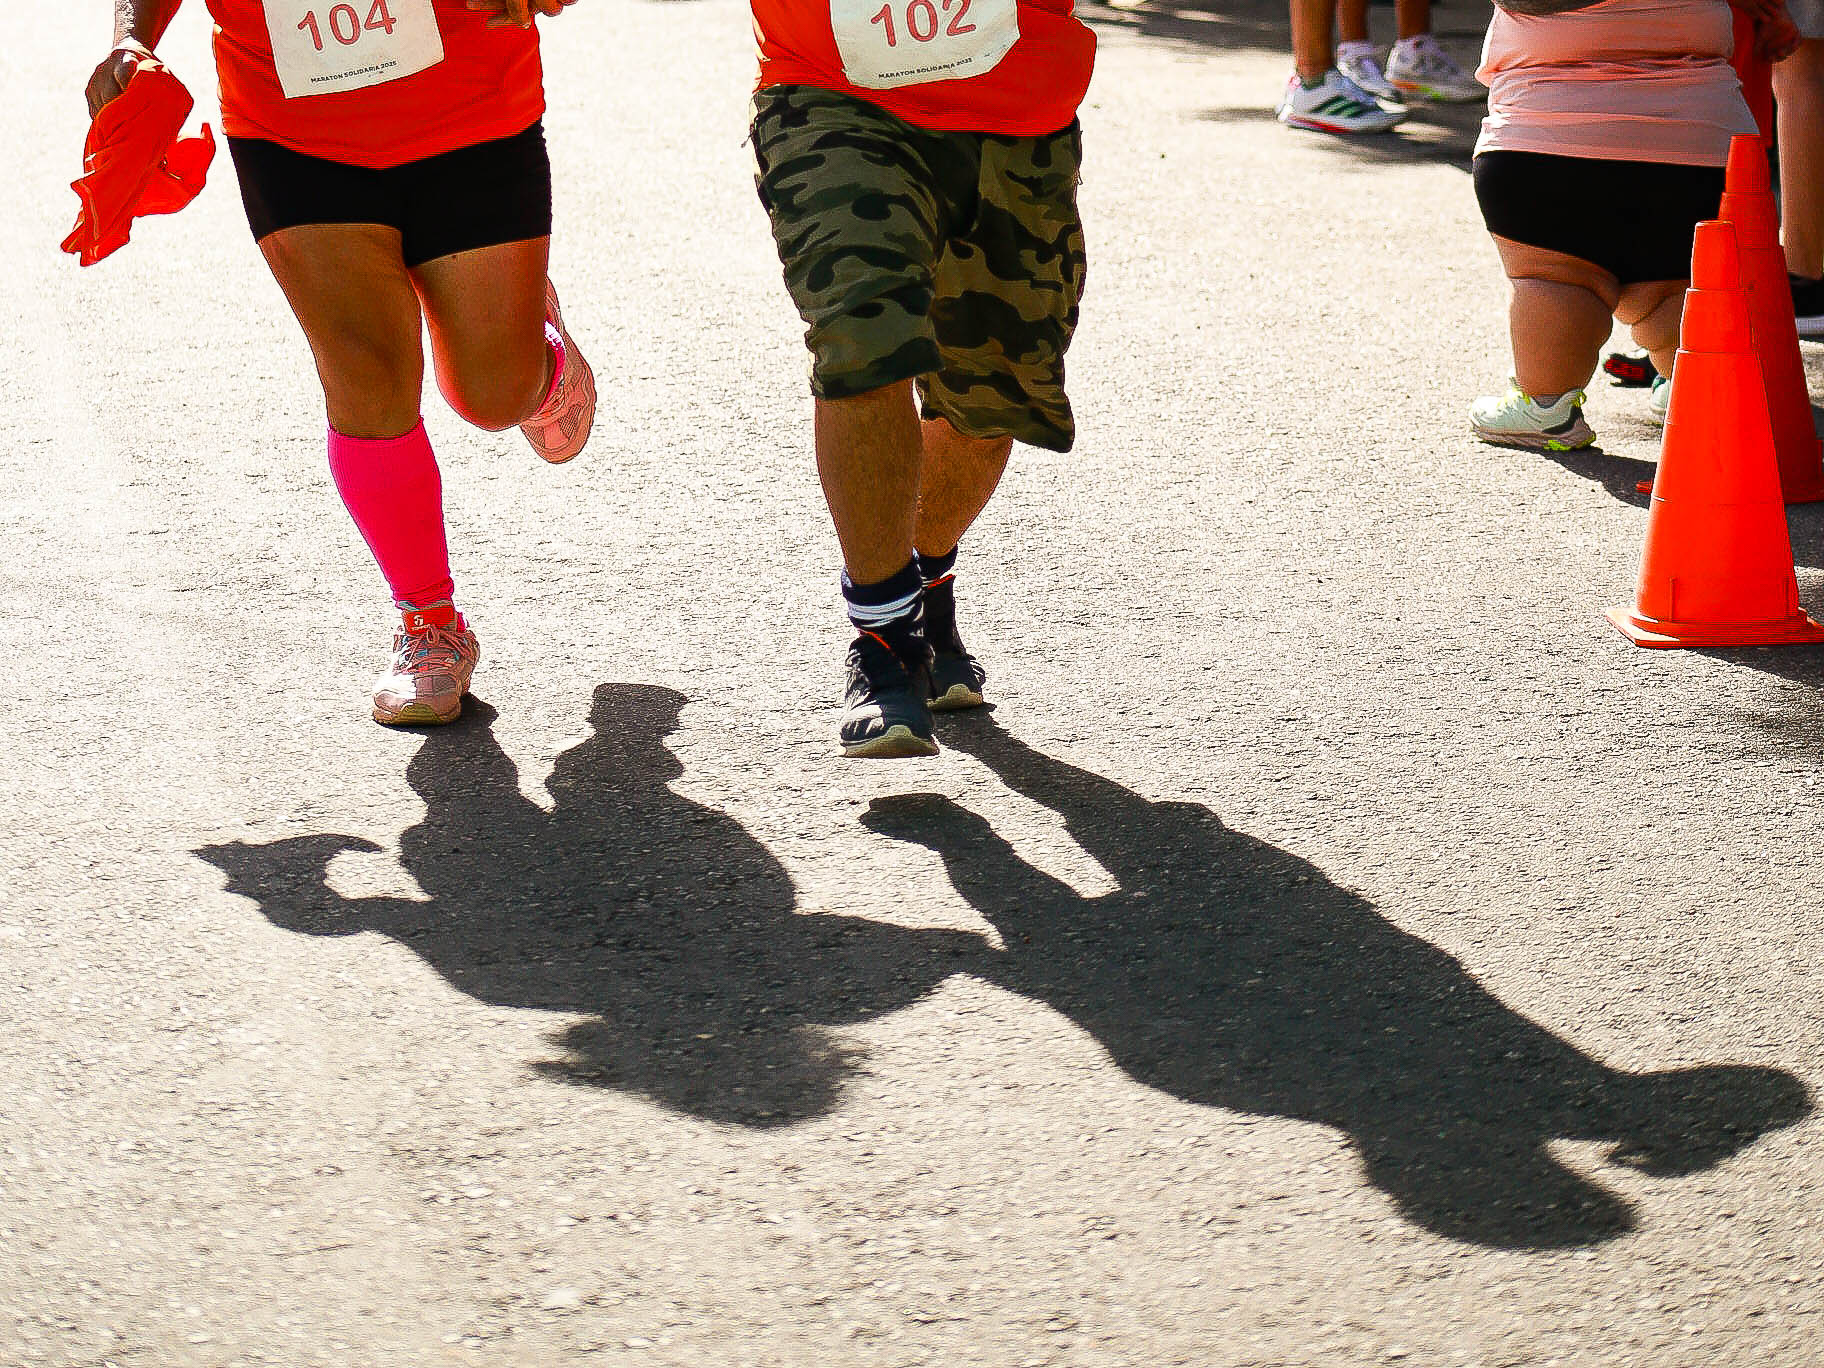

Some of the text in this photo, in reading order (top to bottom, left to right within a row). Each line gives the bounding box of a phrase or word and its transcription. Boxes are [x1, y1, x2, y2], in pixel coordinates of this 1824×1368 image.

[310, 73, 344, 84] MARATON
[344, 65, 380, 78] SOLIDARIA
[878, 69, 915, 79] MARATON
[916, 62, 955, 74] SOLIDARIA
